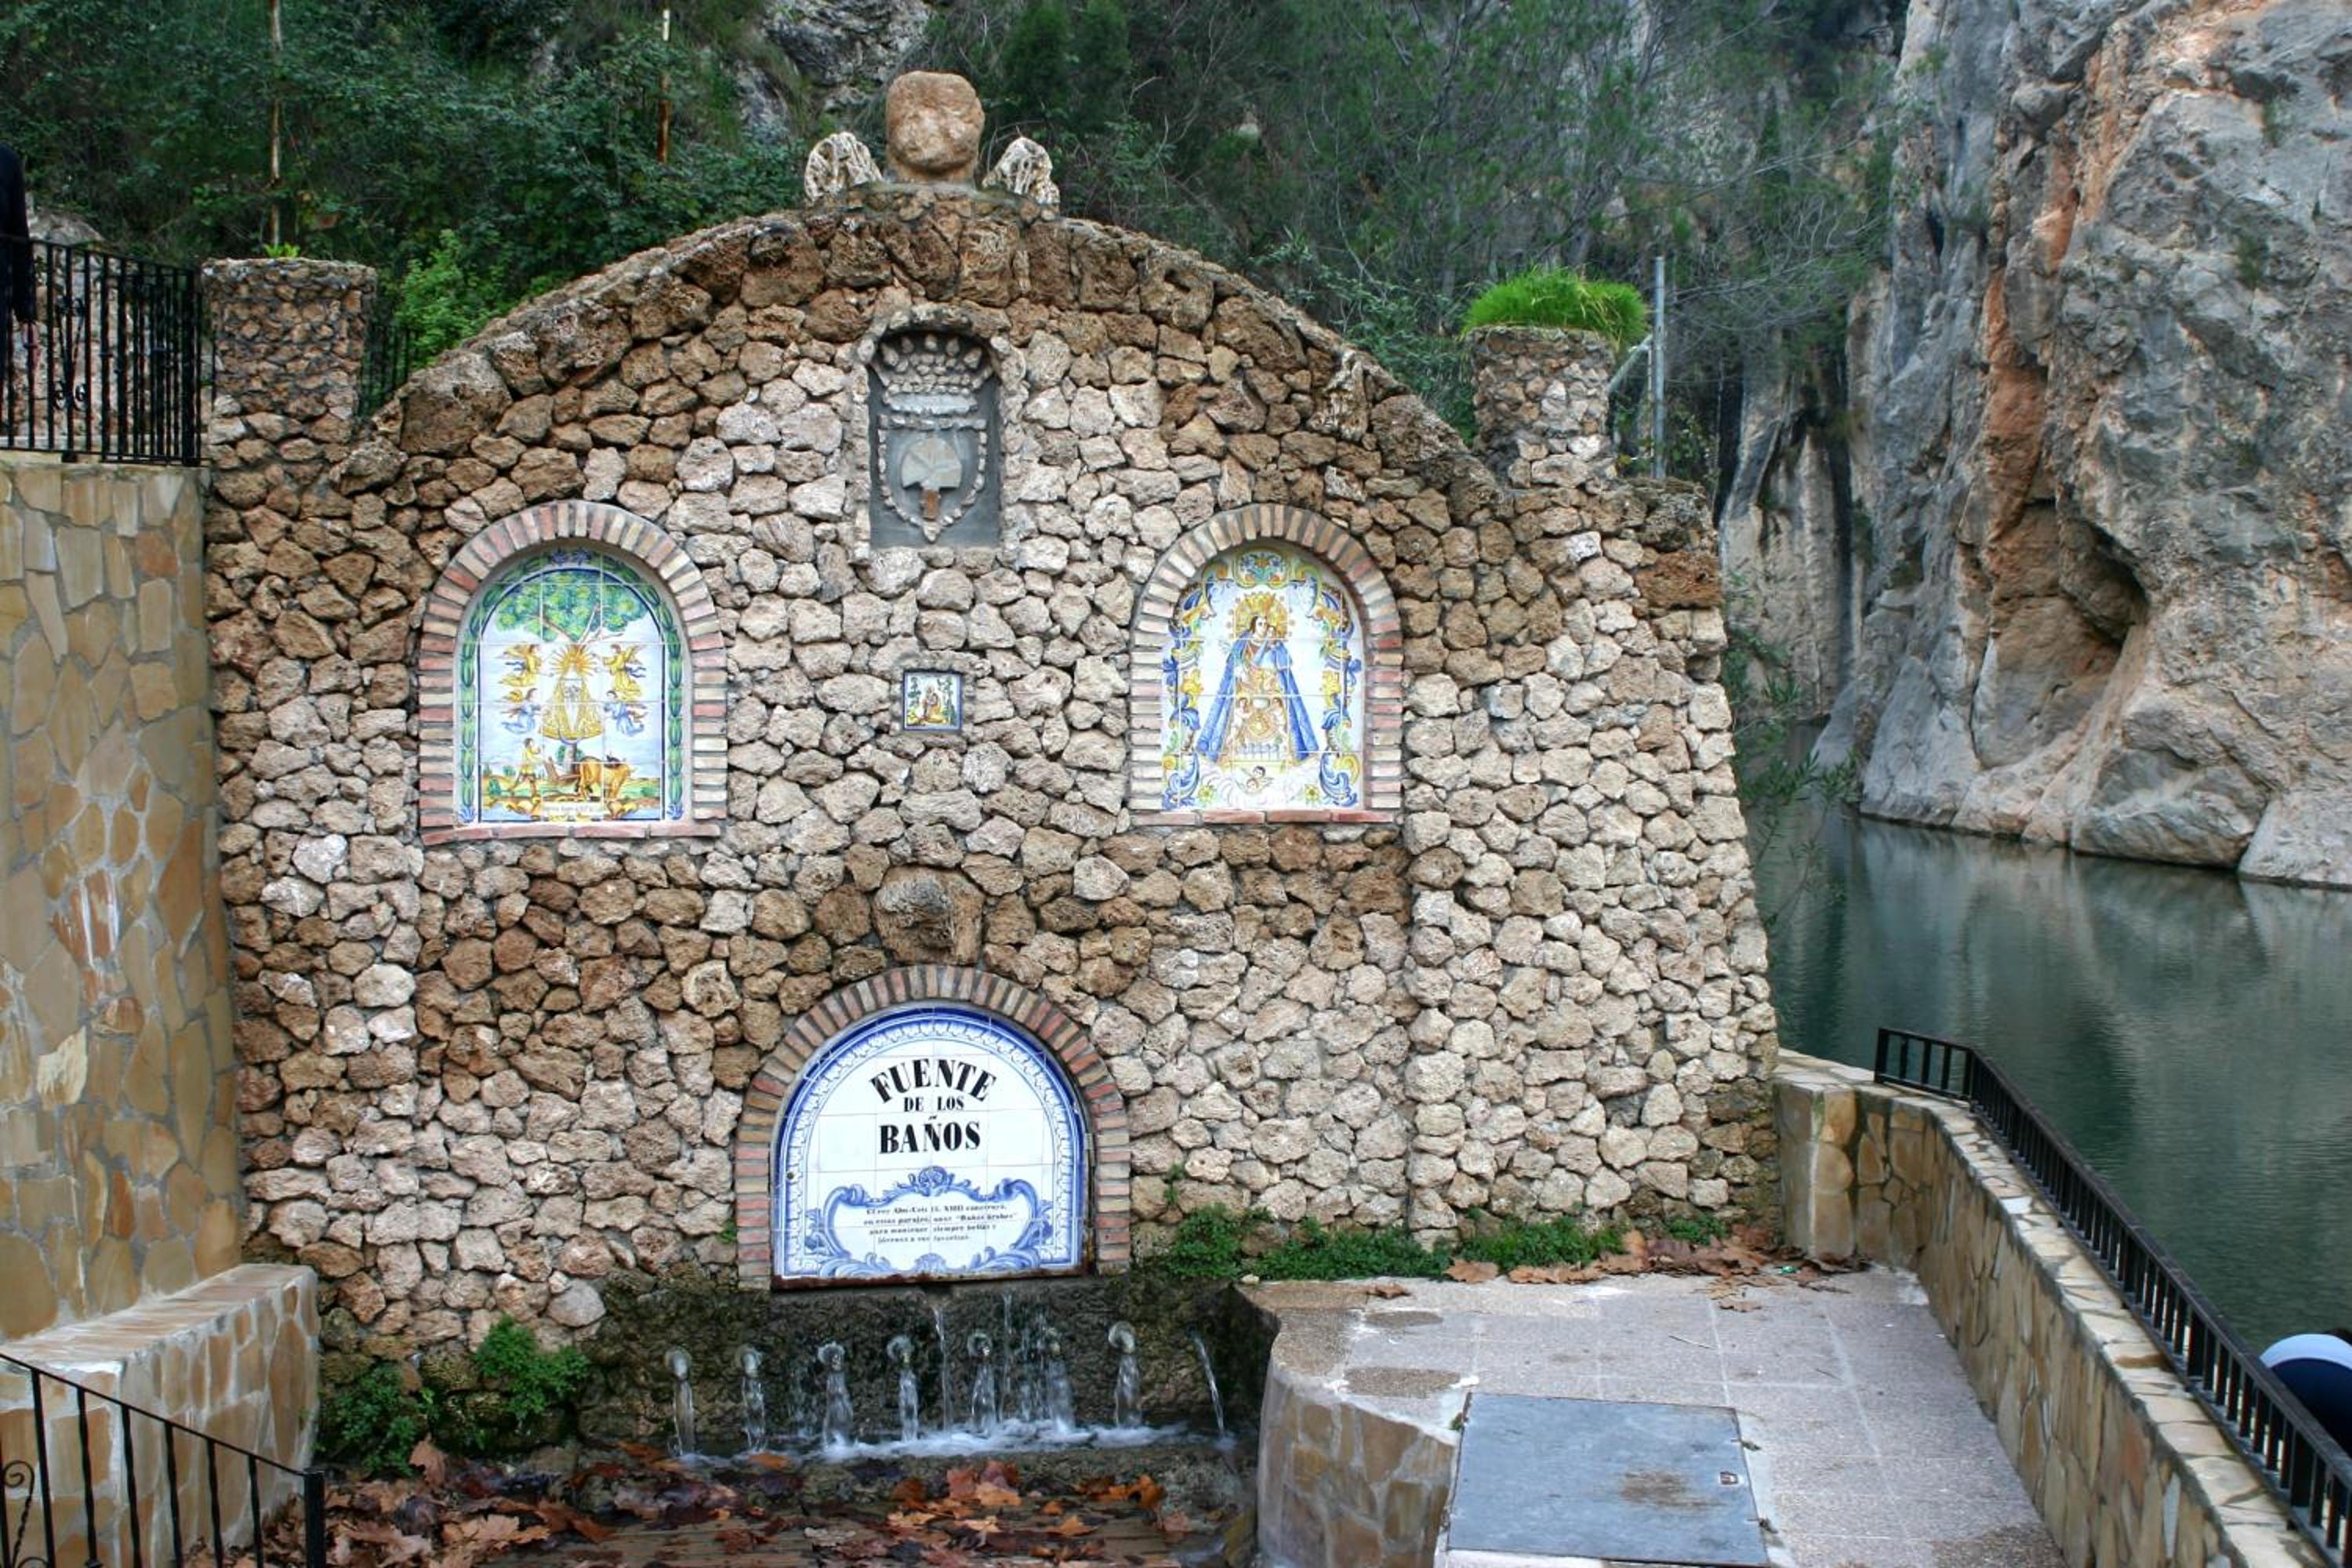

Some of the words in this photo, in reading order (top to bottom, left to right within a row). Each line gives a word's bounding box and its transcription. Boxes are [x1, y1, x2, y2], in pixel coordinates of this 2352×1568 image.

[869, 1058, 997, 1103] FUENTE
[904, 1097, 924, 1112] DE
[937, 1096, 964, 1112] LOS
[879, 1115, 981, 1154] BAÑOS
